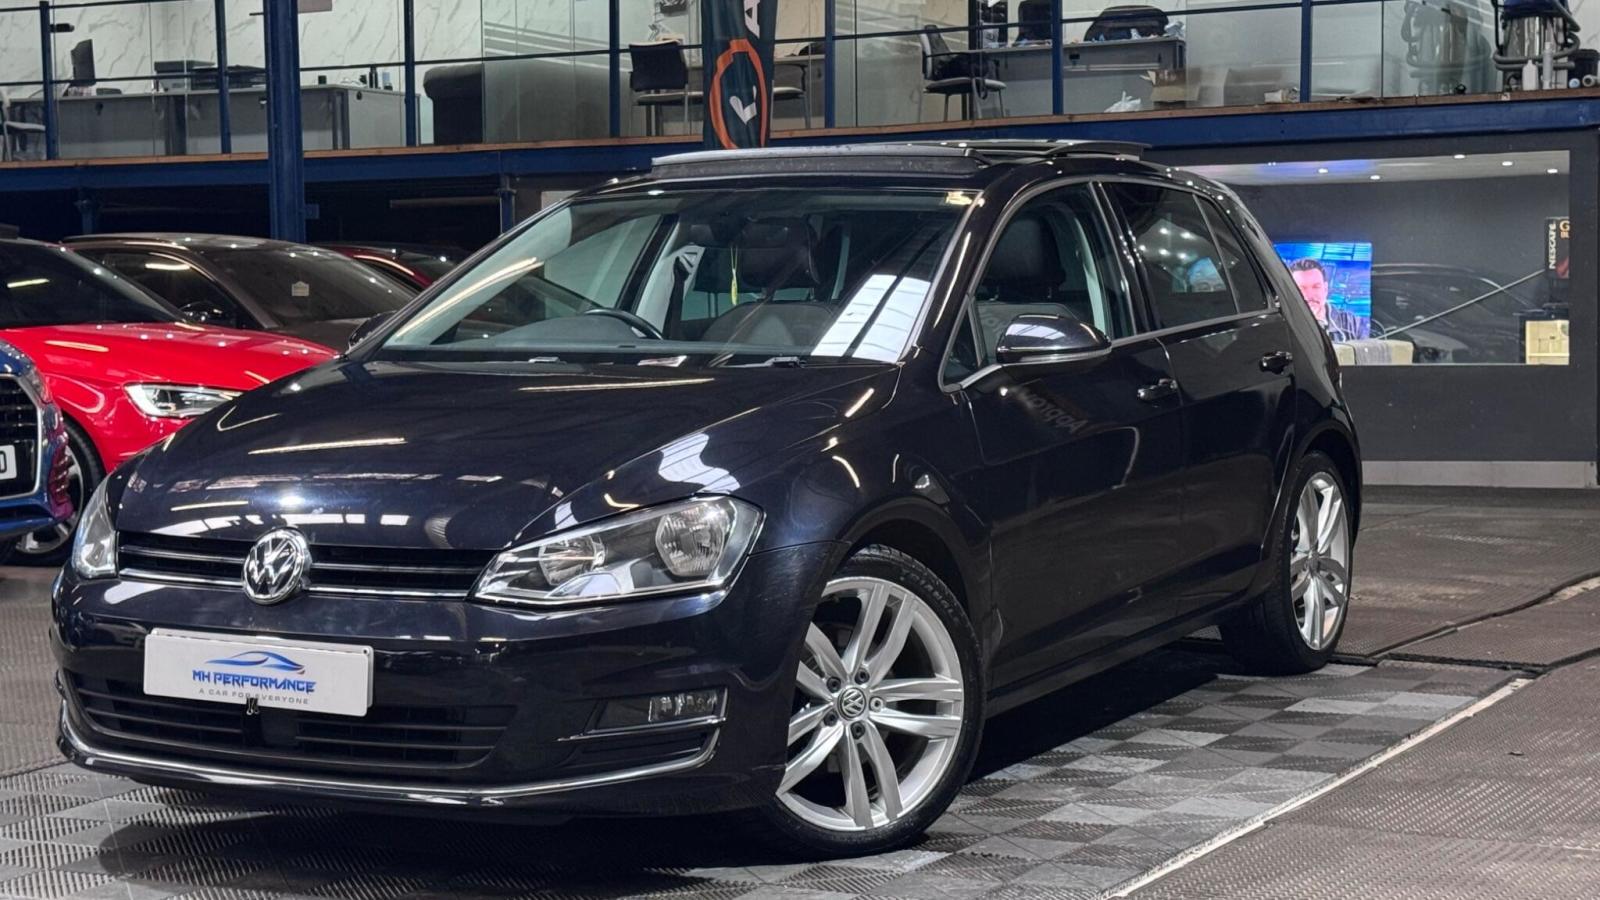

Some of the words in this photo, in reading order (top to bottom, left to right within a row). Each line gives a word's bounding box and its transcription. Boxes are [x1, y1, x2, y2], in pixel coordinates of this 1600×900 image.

[192, 669, 211, 684] MH
[213, 672, 316, 695] PERFORMANCE
[208, 689, 228, 697] CAR
[231, 691, 251, 699] FOR
[254, 694, 309, 705] EVERYONE
